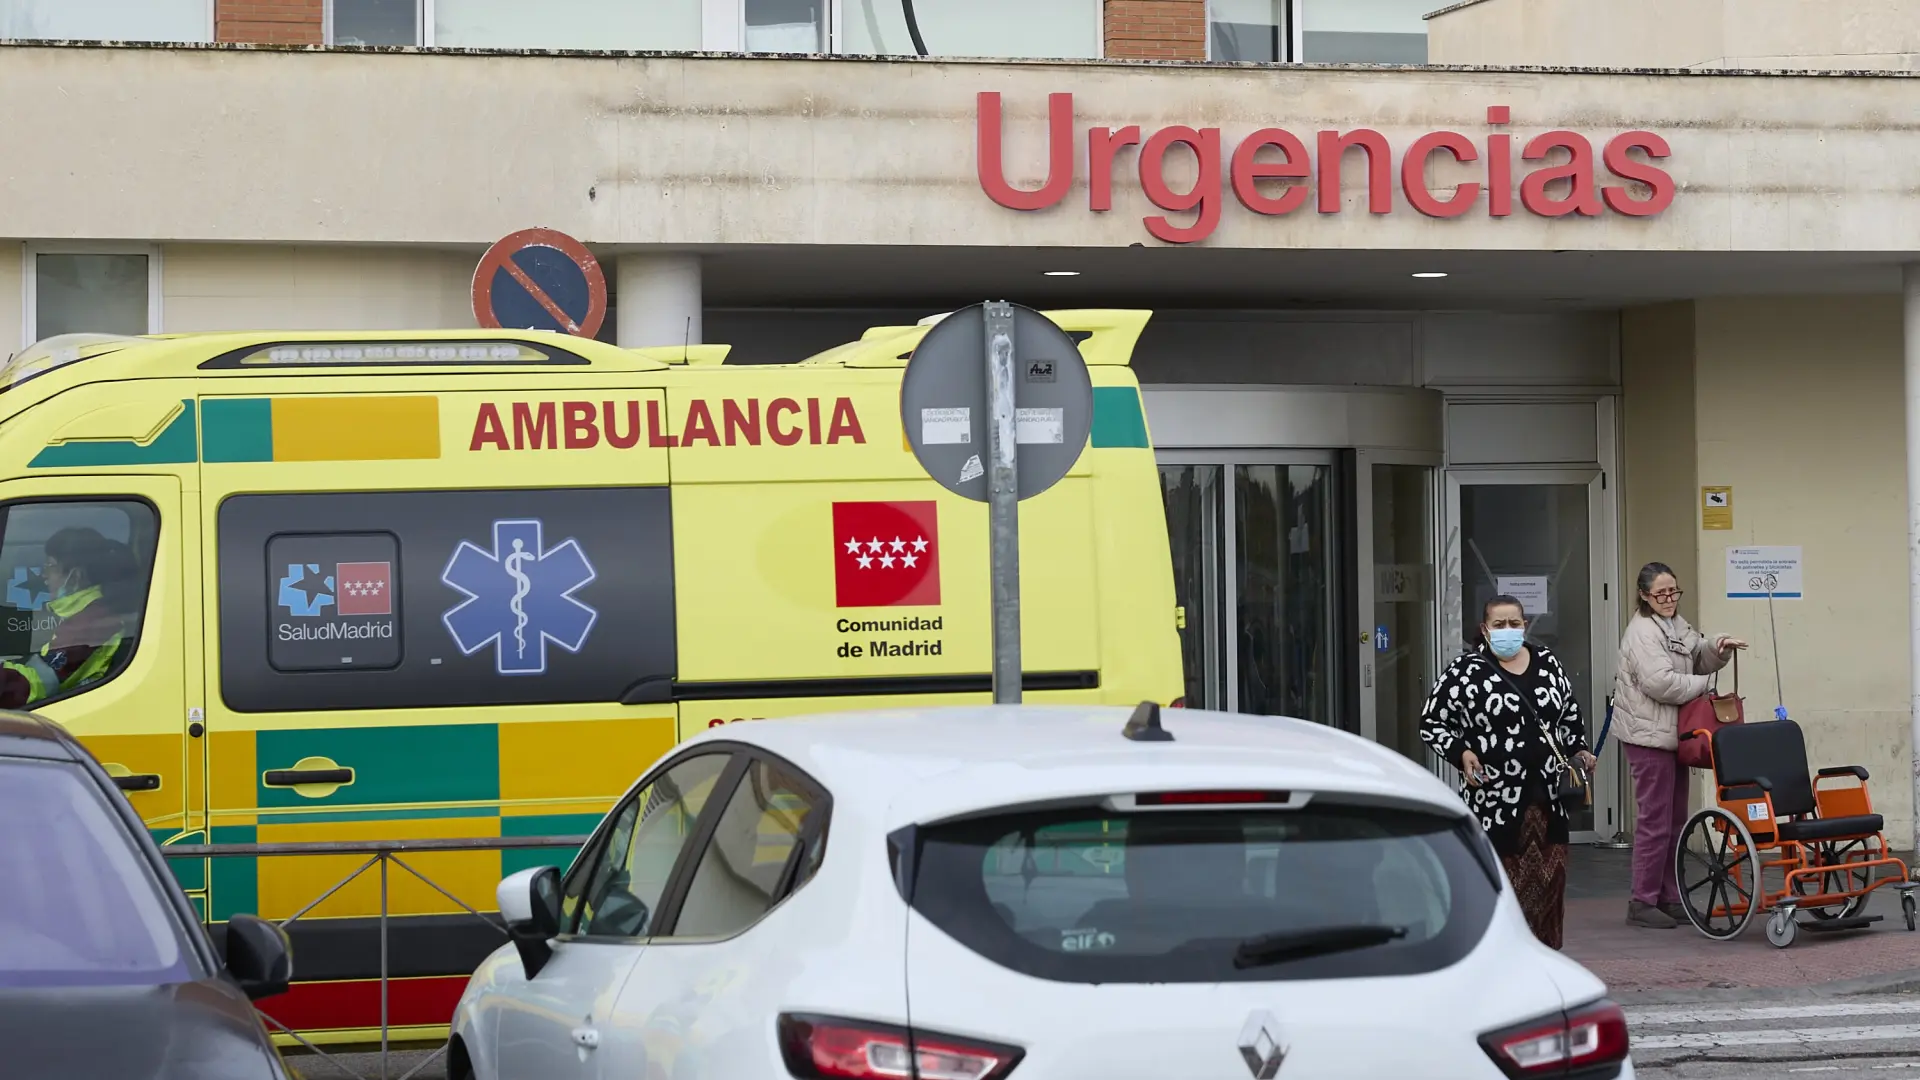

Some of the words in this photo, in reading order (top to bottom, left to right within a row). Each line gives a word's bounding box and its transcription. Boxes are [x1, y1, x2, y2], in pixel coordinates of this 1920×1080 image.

[977, 91, 1676, 243] Urgencias
[469, 397, 867, 451] AMBULANCIA
[7, 615, 65, 633] SaludM
[278, 621, 392, 641] SaludMadrid
[836, 616, 943, 633] Comunidad
[837, 642, 863, 658] de
[870, 640, 942, 657] Madrid
